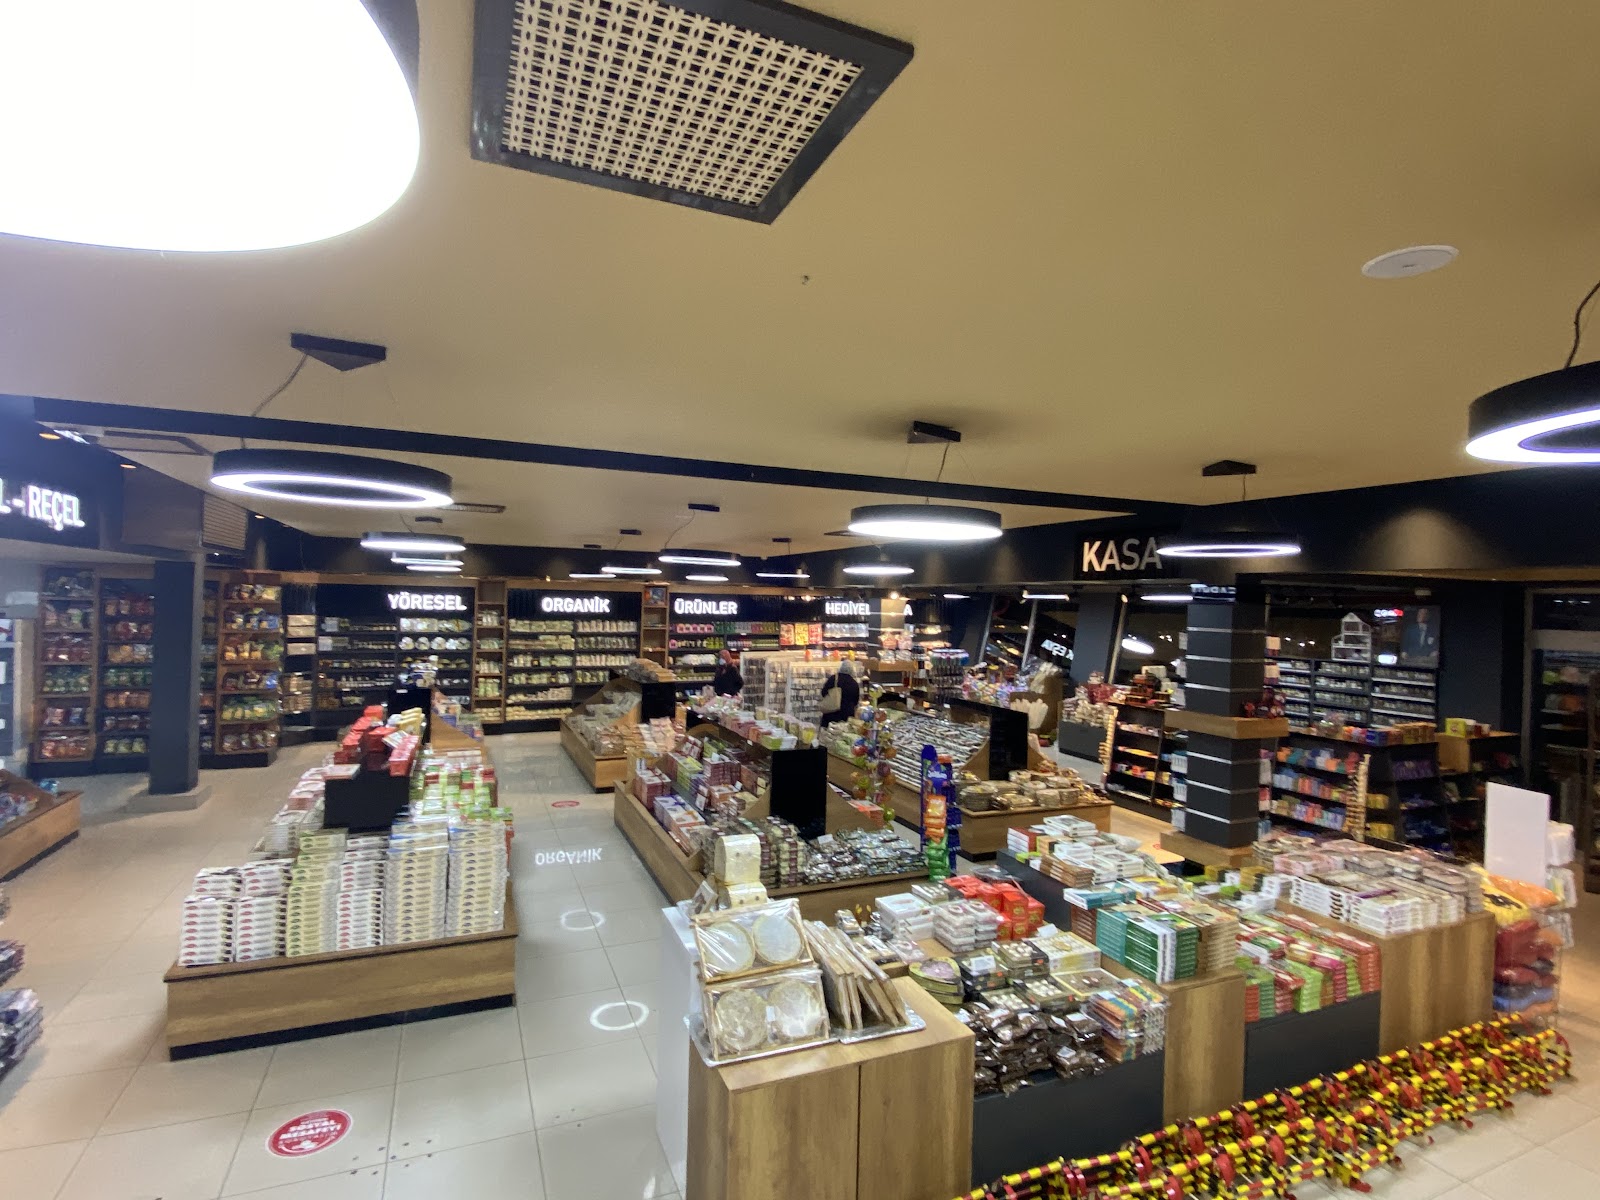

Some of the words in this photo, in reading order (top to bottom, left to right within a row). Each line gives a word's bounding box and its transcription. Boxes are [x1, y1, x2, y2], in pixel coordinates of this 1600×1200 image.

[27, 485, 86, 531] REÇEL
[1082, 537, 1164, 573] KASA
[387, 591, 468, 611] YÖRESEL
[541, 595, 611, 613] ORGANİK
[674, 597, 738, 615] ÜRÜNLER
